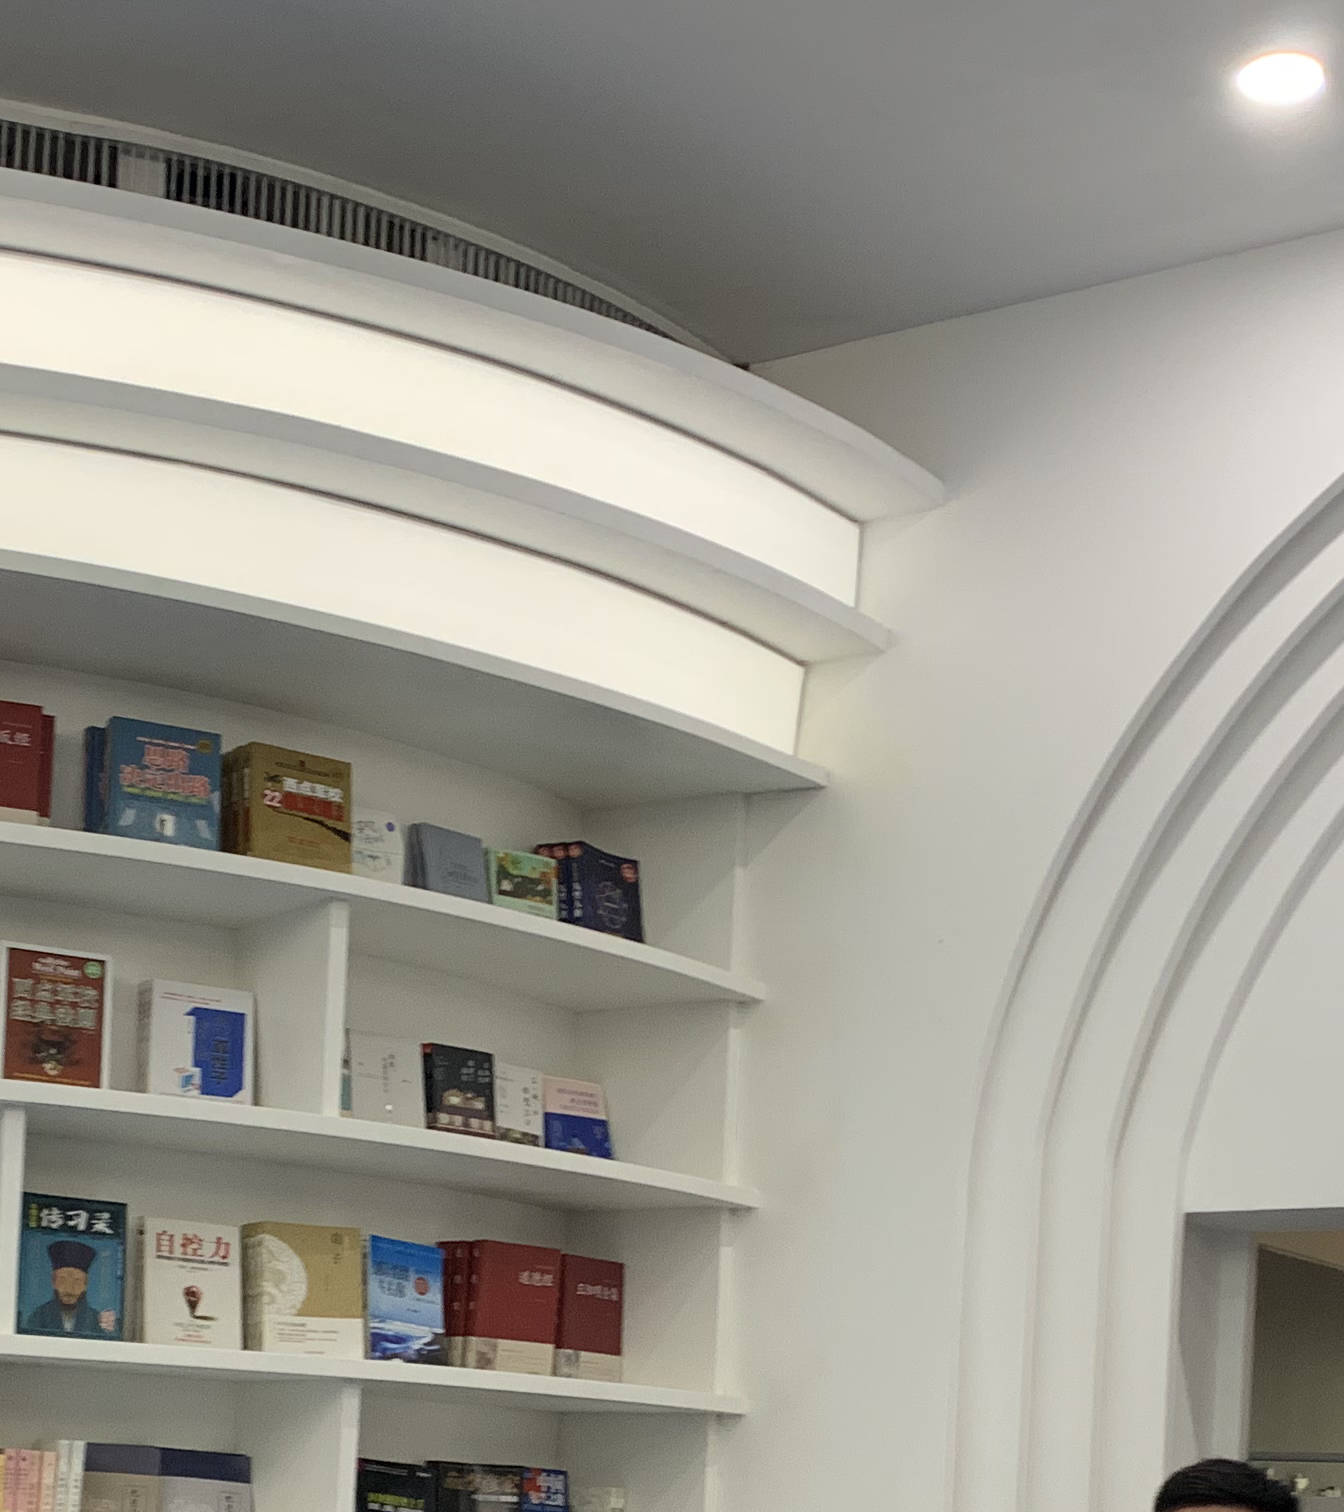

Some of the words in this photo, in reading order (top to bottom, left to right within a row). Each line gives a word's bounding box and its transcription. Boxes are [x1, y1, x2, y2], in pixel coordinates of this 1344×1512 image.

[263, 789, 283, 808] 22
[156, 1230, 231, 1260] 自控力
